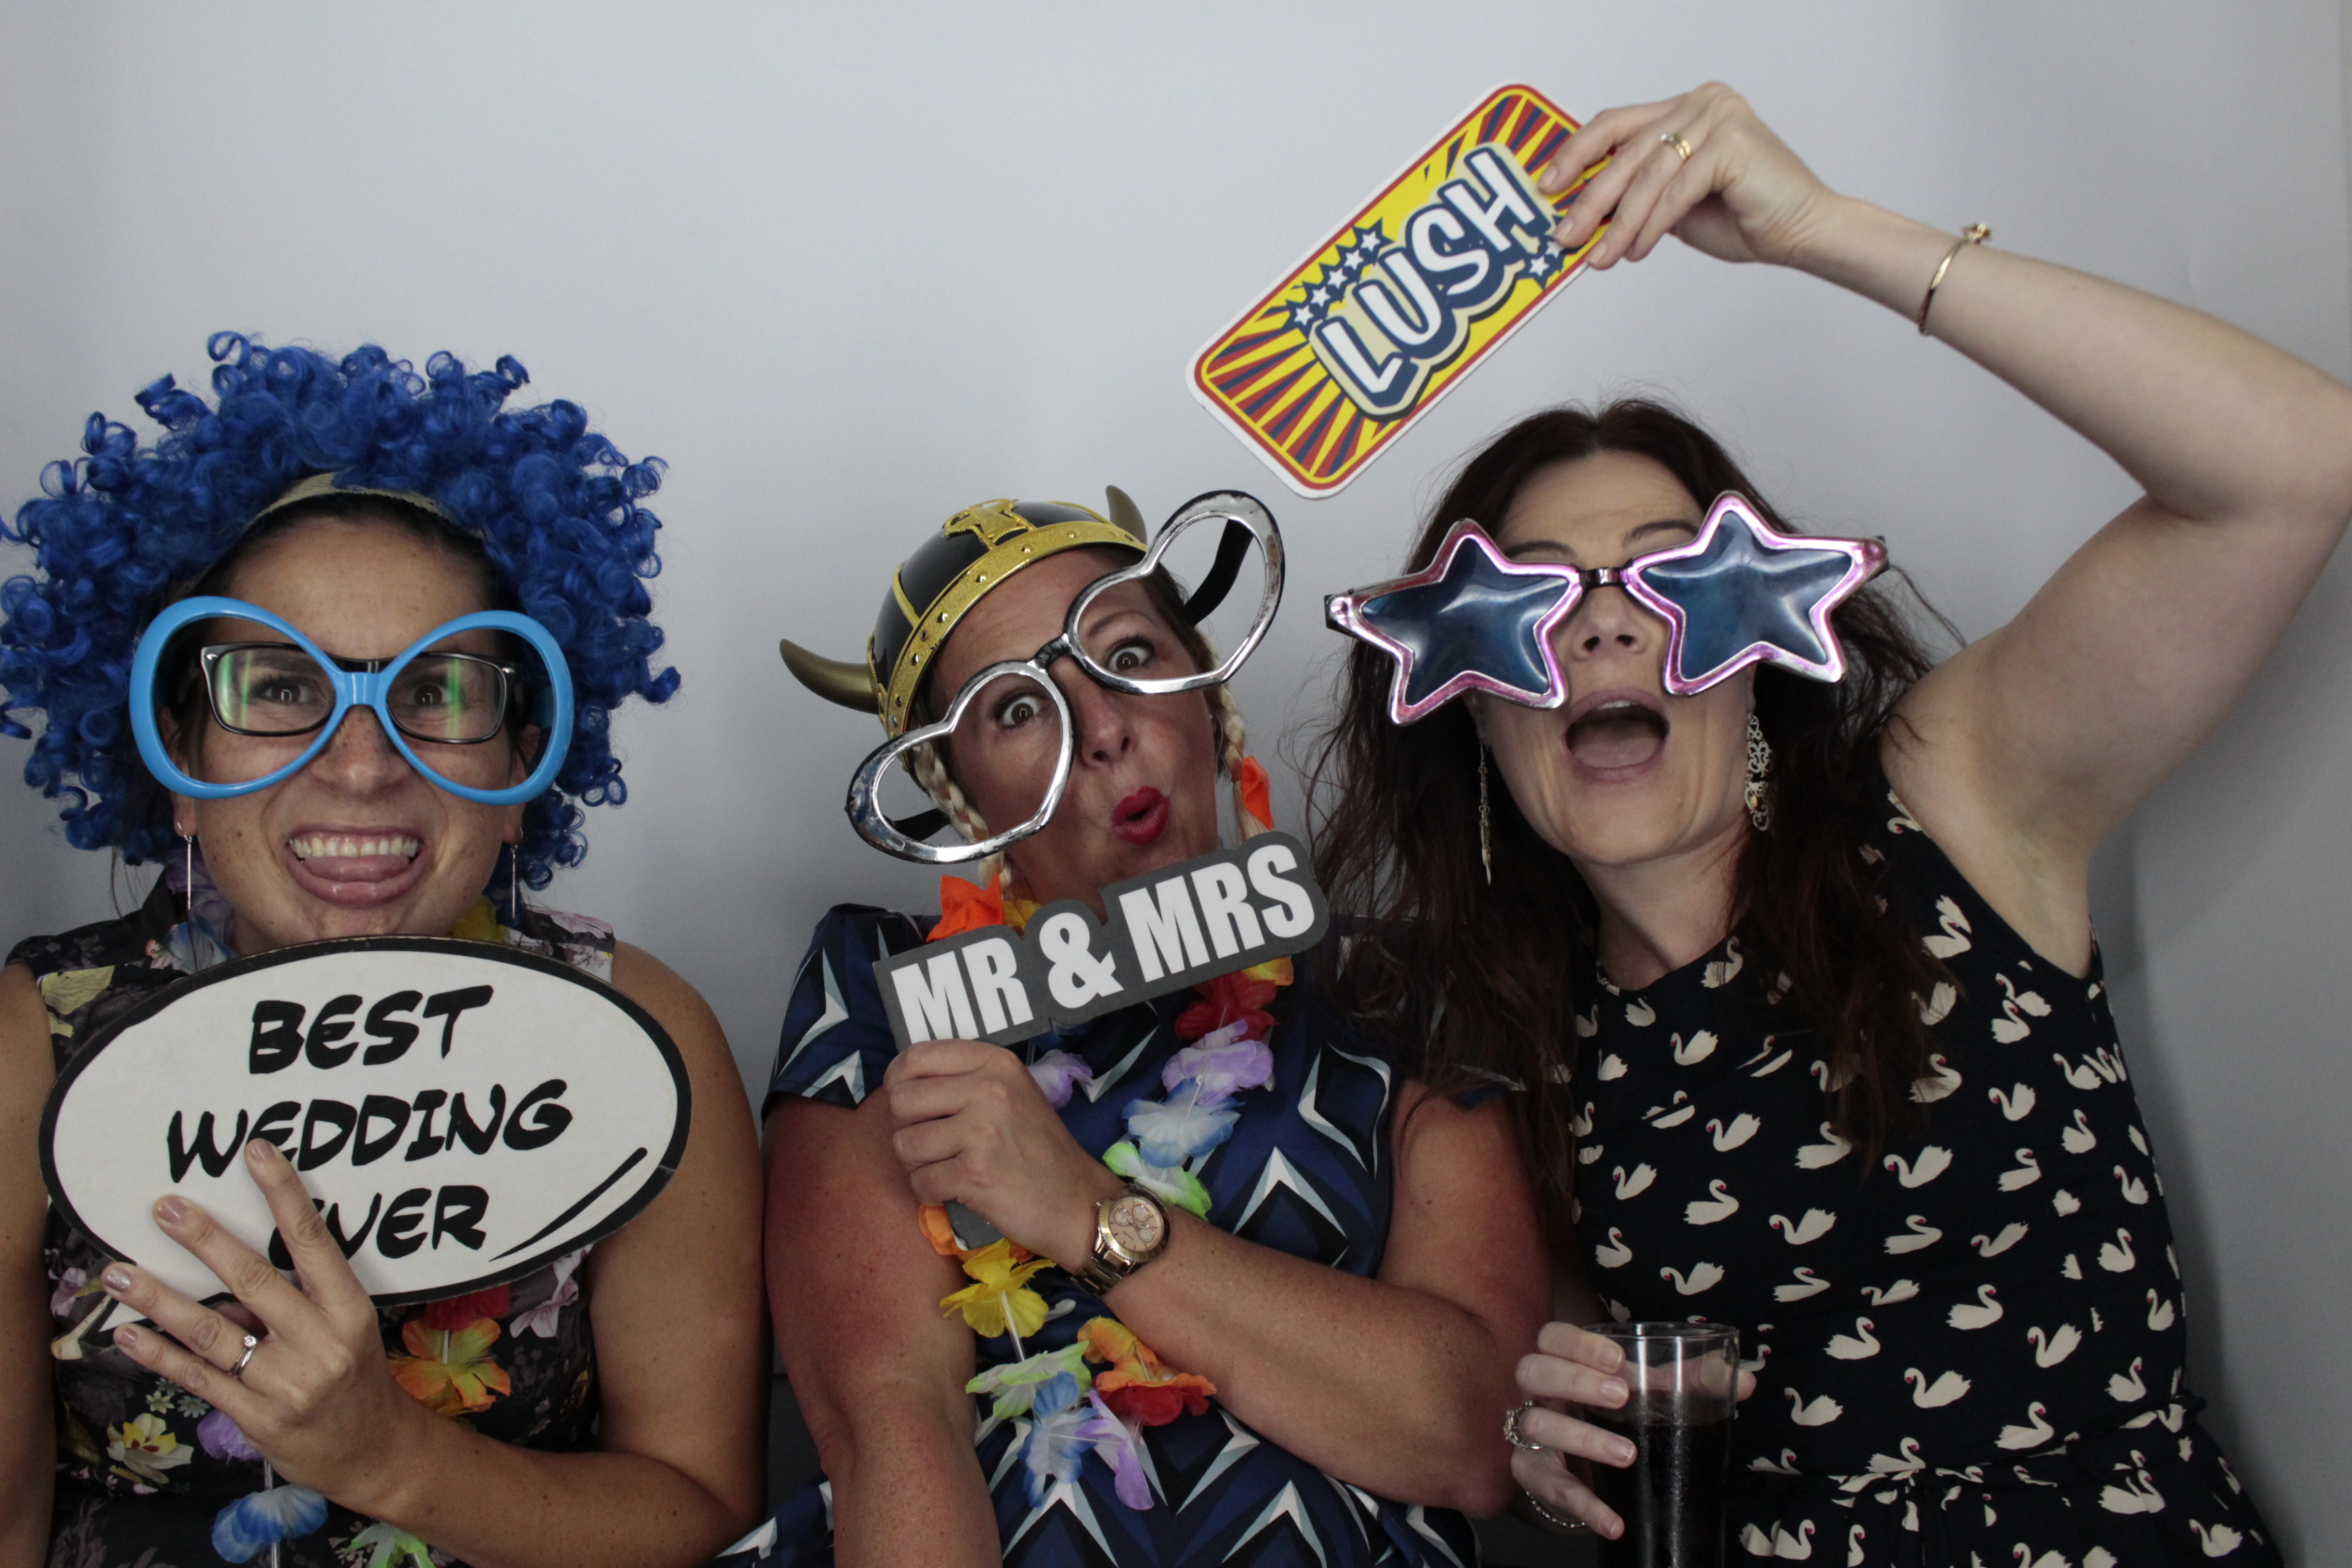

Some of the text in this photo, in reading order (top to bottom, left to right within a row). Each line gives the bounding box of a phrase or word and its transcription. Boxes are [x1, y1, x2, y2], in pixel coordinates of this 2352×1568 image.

[1316, 147, 1544, 403] LUSH
[890, 844, 1316, 1045] MR & MRS
[248, 984, 494, 1075] BEST
[166, 1078, 574, 1183] WEDDING
